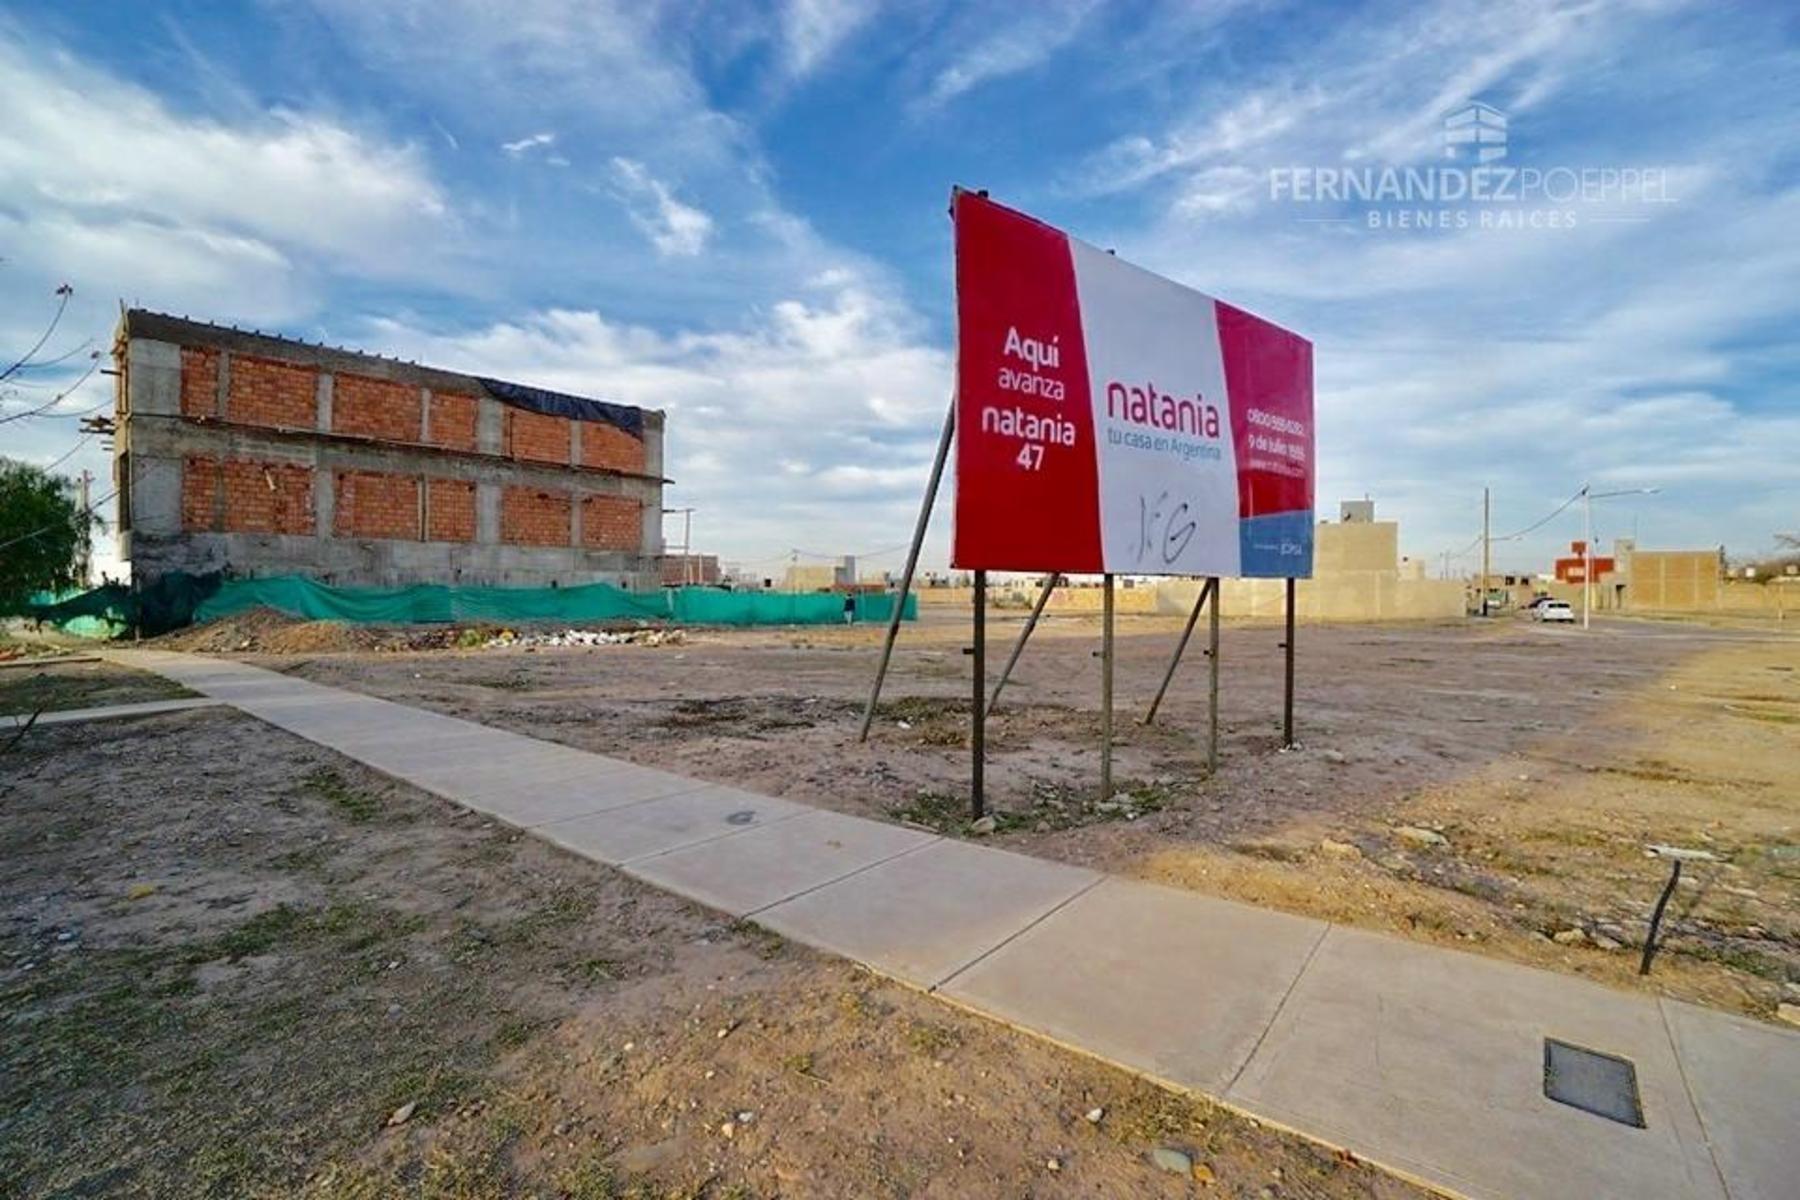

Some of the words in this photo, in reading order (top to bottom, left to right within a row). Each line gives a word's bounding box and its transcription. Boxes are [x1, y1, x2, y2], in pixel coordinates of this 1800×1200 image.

[1003, 325, 1060, 373] Aquí
[998, 367, 1065, 401] avanza
[981, 406, 1076, 447] natania
[1107, 381, 1220, 440] natania
[1016, 442, 1045, 472] 47
[1107, 427, 1122, 445] tu
[1124, 431, 1152, 450] casa
[1154, 437, 1169, 451] en
[1171, 438, 1222, 461] Argentina
